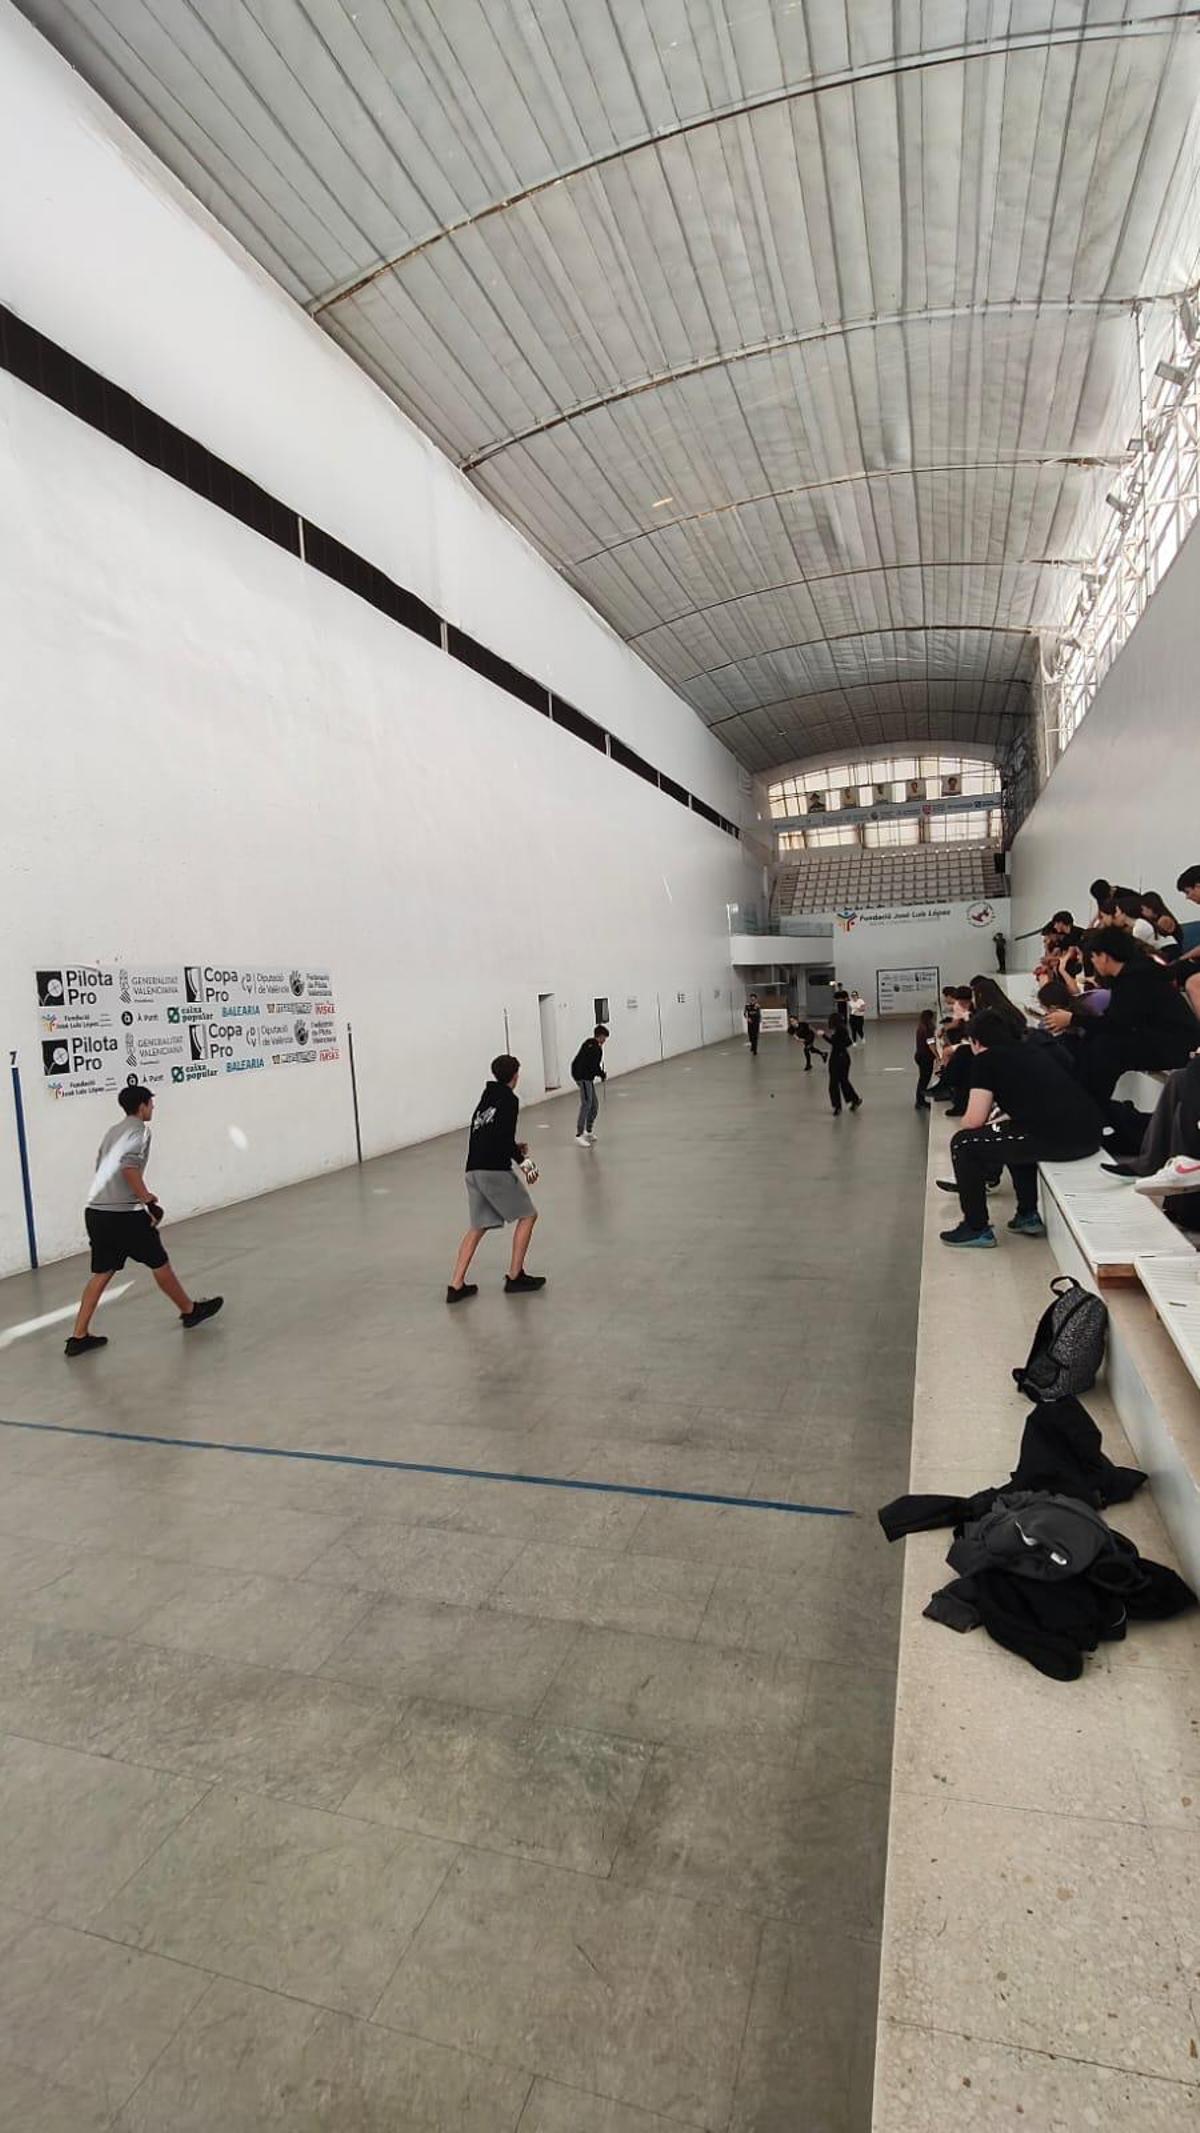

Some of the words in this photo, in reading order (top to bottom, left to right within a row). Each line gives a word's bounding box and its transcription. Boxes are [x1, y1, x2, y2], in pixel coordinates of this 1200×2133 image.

[66, 970, 113, 987] Pilota
[204, 967, 238, 985] Copa
[68, 989, 97, 1005] Pro
[205, 988, 230, 1002] Pro
[182, 1012, 214, 1022] popular
[208, 1023, 243, 1041] Copa
[71, 1036, 118, 1055] Pilota
[210, 1044, 234, 1059] Pro
[9, 1050, 17, 1065] 7
[73, 1055, 103, 1073] Pro
[185, 1064, 207, 1072] caixa
[186, 1069, 218, 1081] popular
